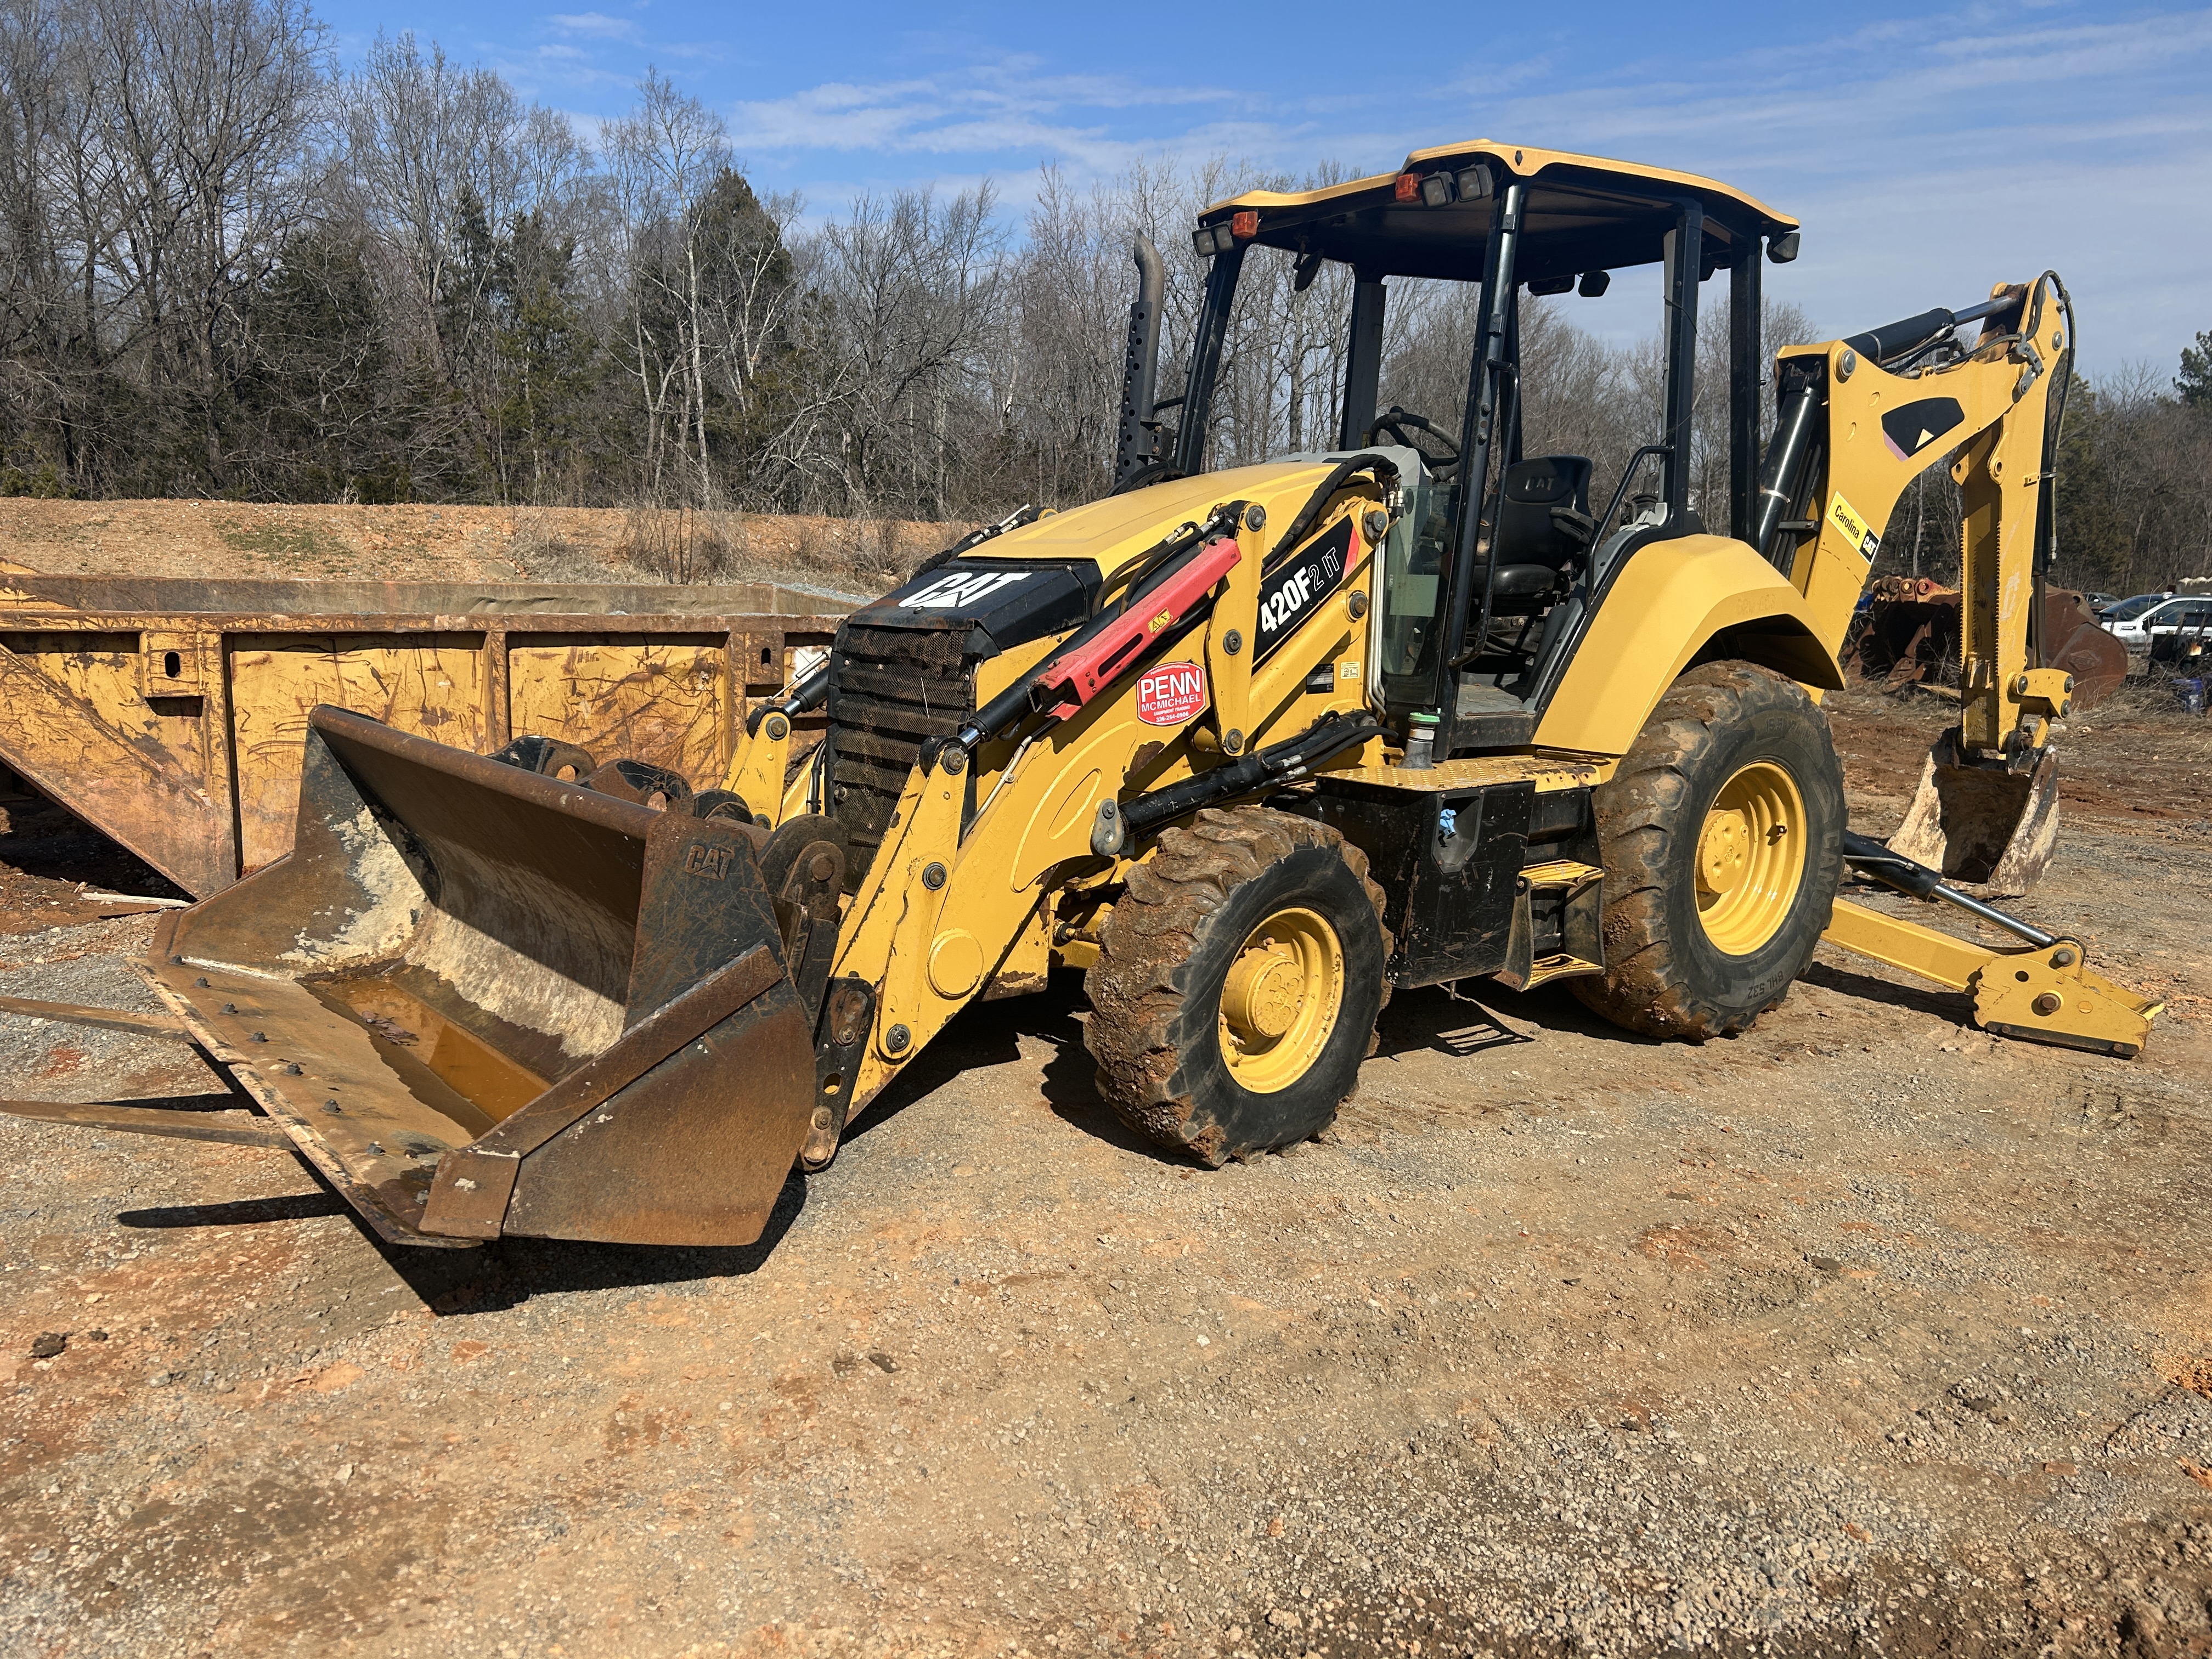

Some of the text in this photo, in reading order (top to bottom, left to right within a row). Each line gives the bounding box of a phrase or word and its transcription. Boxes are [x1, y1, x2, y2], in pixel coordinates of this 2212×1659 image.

[1525, 476, 1555, 492] CAT
[1835, 505, 1877, 556] Carolina CAT
[1321, 546, 1340, 579] IT
[898, 572, 1033, 608] CAT
[1141, 669, 1201, 703] PENN
[1141, 693, 1201, 713] MCMICHAEL
[1153, 708, 1175, 716] EQUIPMENT
[684, 844, 735, 882] CAT
[1802, 830, 1840, 934] CAMSO
[1747, 970, 1784, 1000] BHL 532
